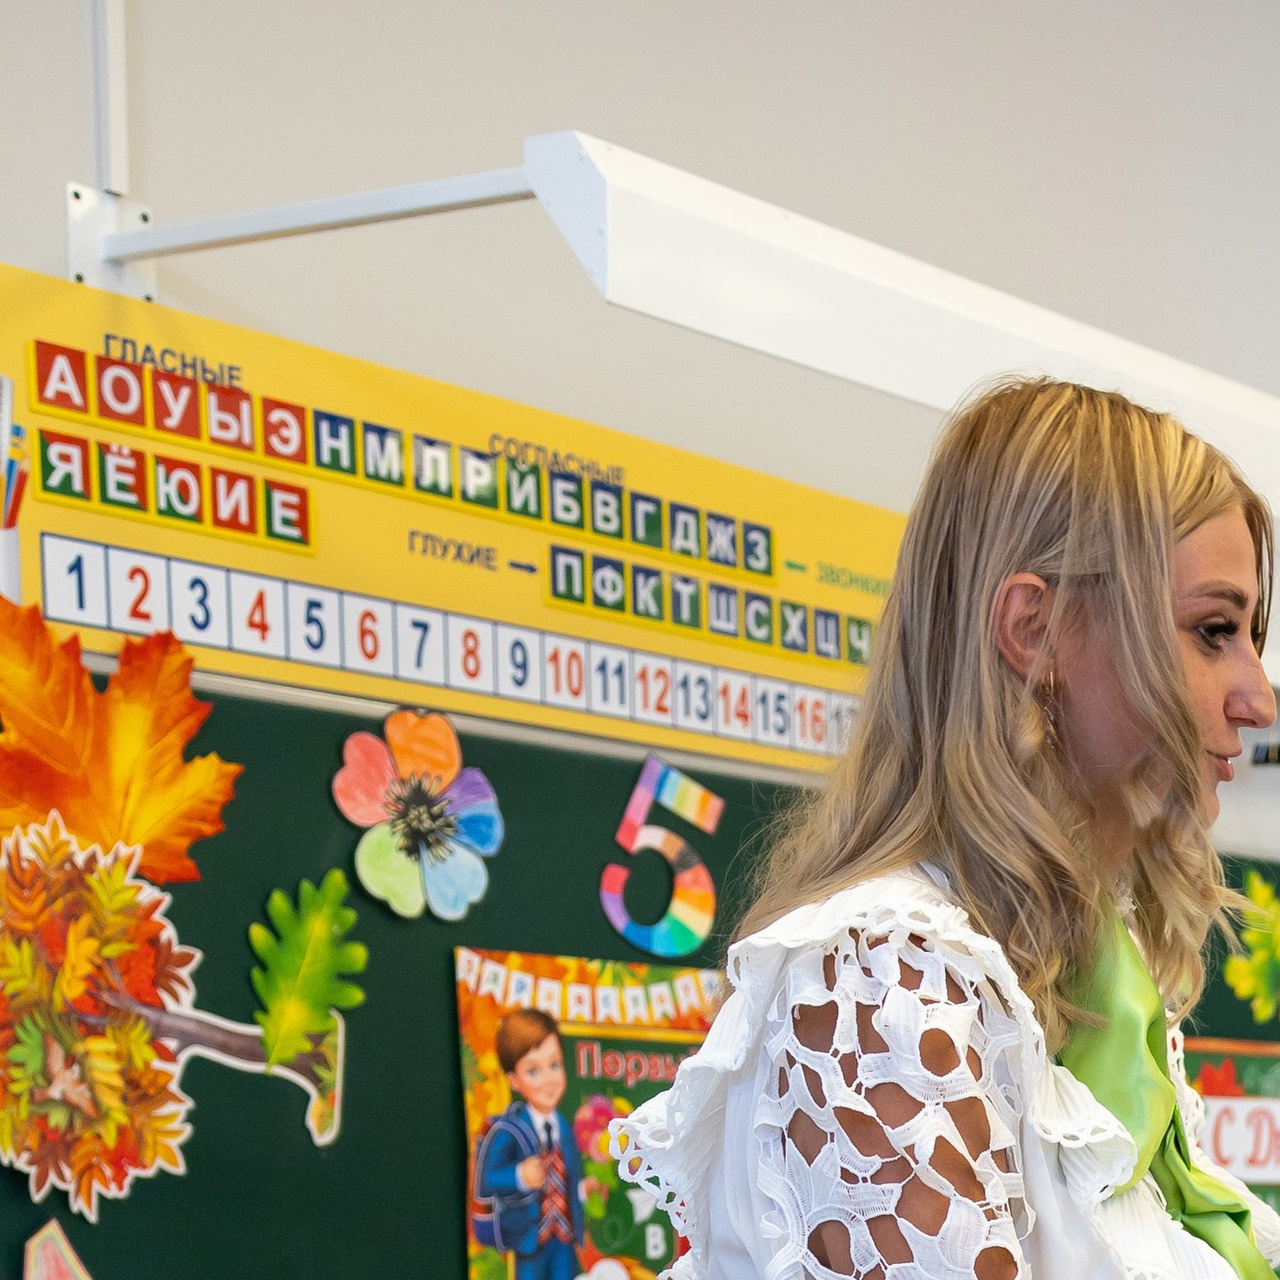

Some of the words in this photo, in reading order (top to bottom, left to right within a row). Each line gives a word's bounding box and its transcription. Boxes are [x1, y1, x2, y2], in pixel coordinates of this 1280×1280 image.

[103, 333, 243, 390] ГЛАСНЫЕ
[408, 529, 498, 572] ГЛУХИЕ
[66, 554, 86, 611] 1
[128, 565, 152, 622] 2
[188, 576, 212, 631] 3
[247, 589, 270, 642] 4
[304, 599, 327, 651] 5
[357, 609, 380, 662] 6
[411, 619, 433, 669] 7
[460, 628, 482, 681] 8
[508, 638, 530, 687] 9
[547, 645, 584, 698] 10
[596, 657, 627, 706] 11
[636, 665, 672, 716] 12
[677, 673, 711, 722] 13
[717, 680, 751, 728] 14
[755, 688, 789, 736] 15
[795, 696, 827, 743] 16
[1211, 1106, 1235, 1167] С
